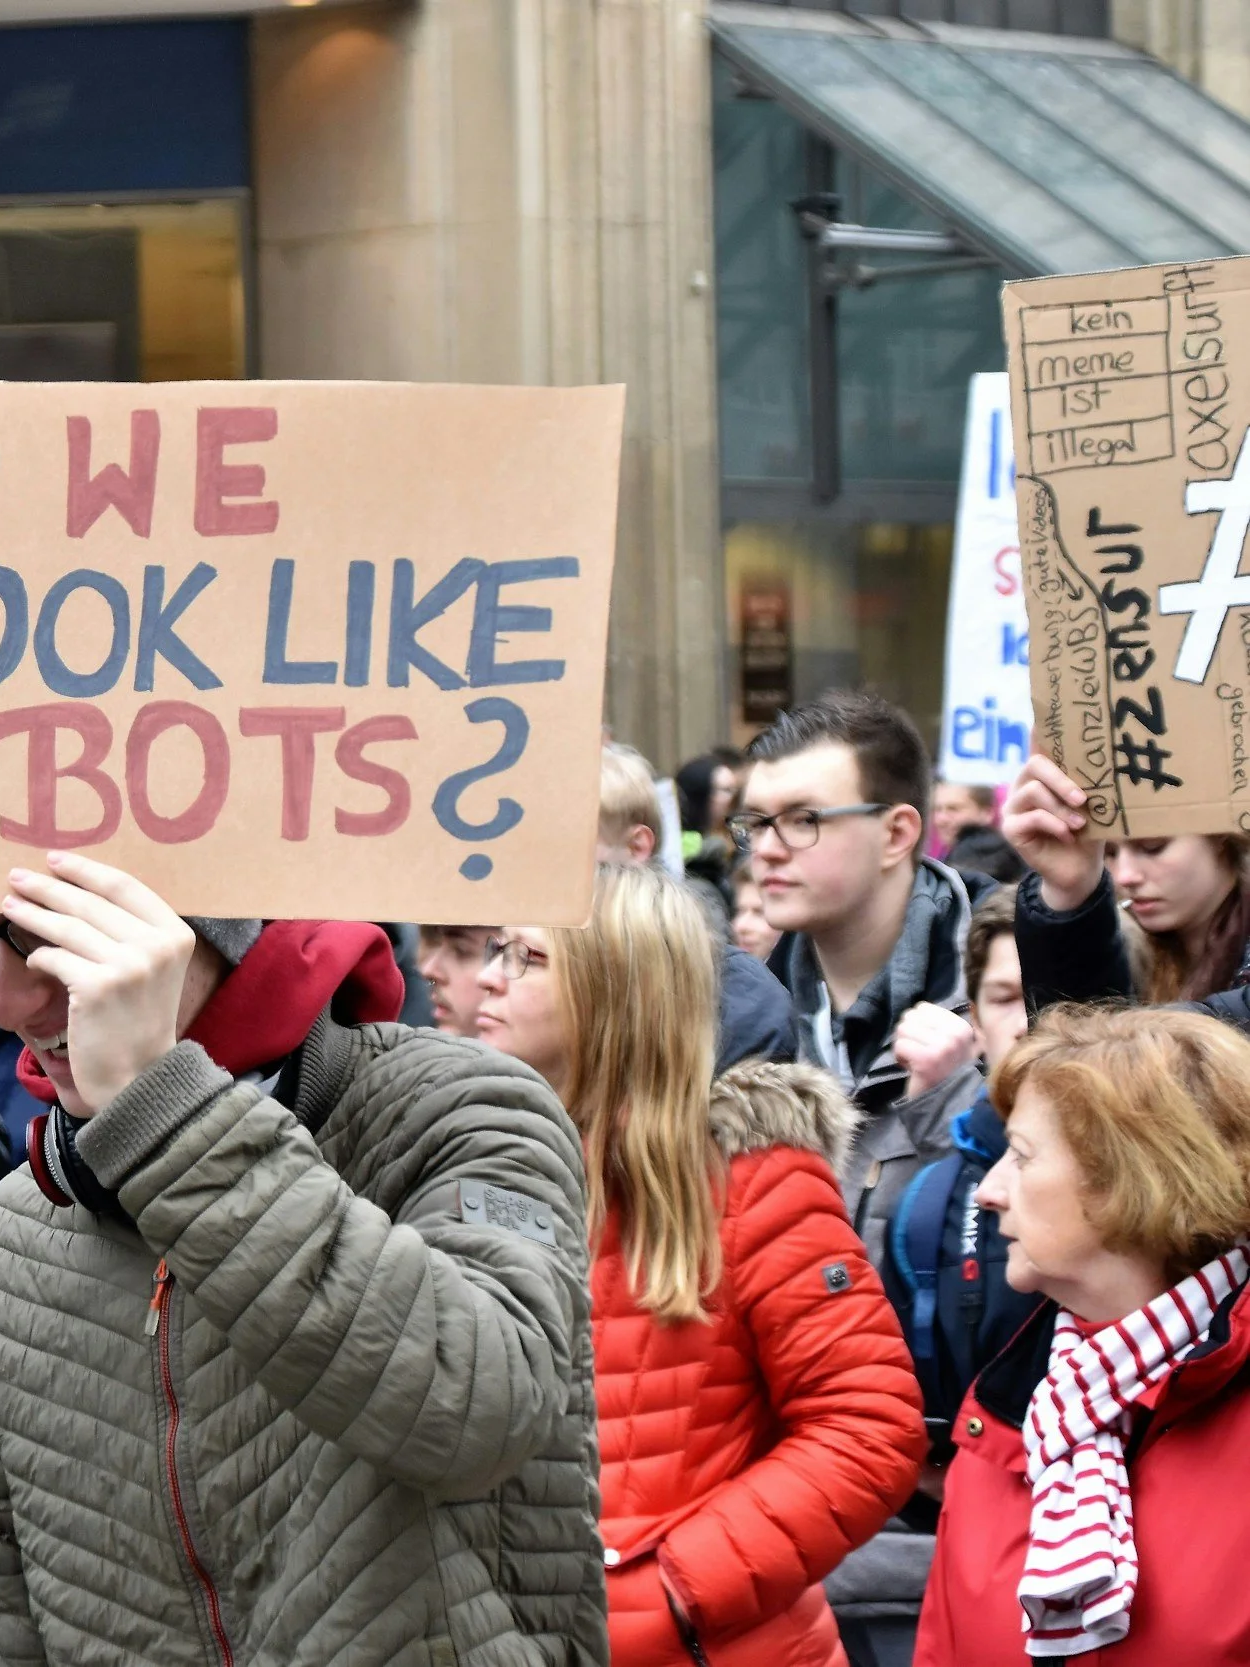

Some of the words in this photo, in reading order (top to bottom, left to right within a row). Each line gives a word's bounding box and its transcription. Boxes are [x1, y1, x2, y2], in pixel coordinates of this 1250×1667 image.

[1069, 301, 1133, 334] kein
[1059, 382, 1112, 418] ist
[1046, 422, 1136, 465] illegal
[66, 406, 280, 538] WE
[262, 556, 580, 692] LIKE
